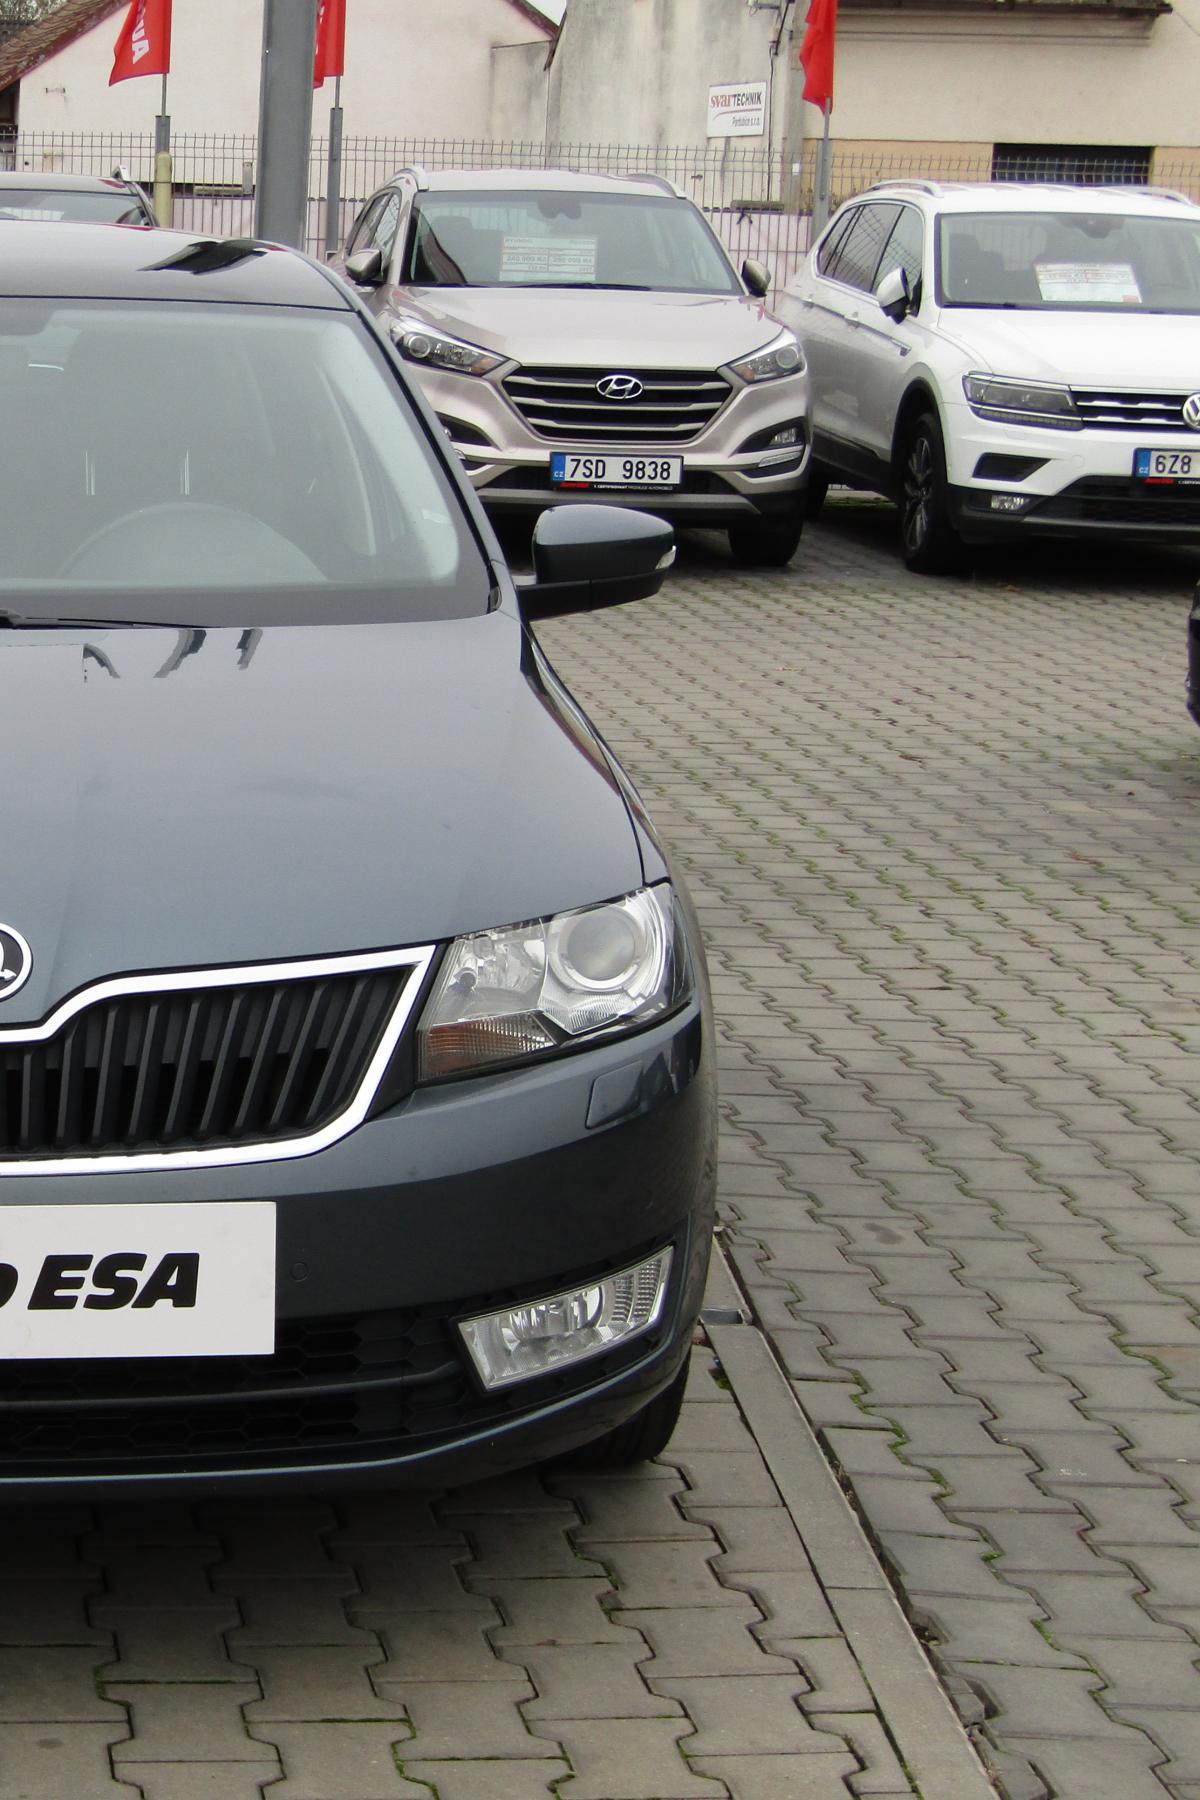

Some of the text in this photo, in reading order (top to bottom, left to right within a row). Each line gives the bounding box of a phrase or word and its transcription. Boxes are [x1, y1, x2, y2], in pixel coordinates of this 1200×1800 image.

[570, 458, 606, 479] 7SD
[622, 460, 671, 481] 9838
[1155, 454, 1192, 474] 6Z8
[27, 1252, 200, 1311] ESA
